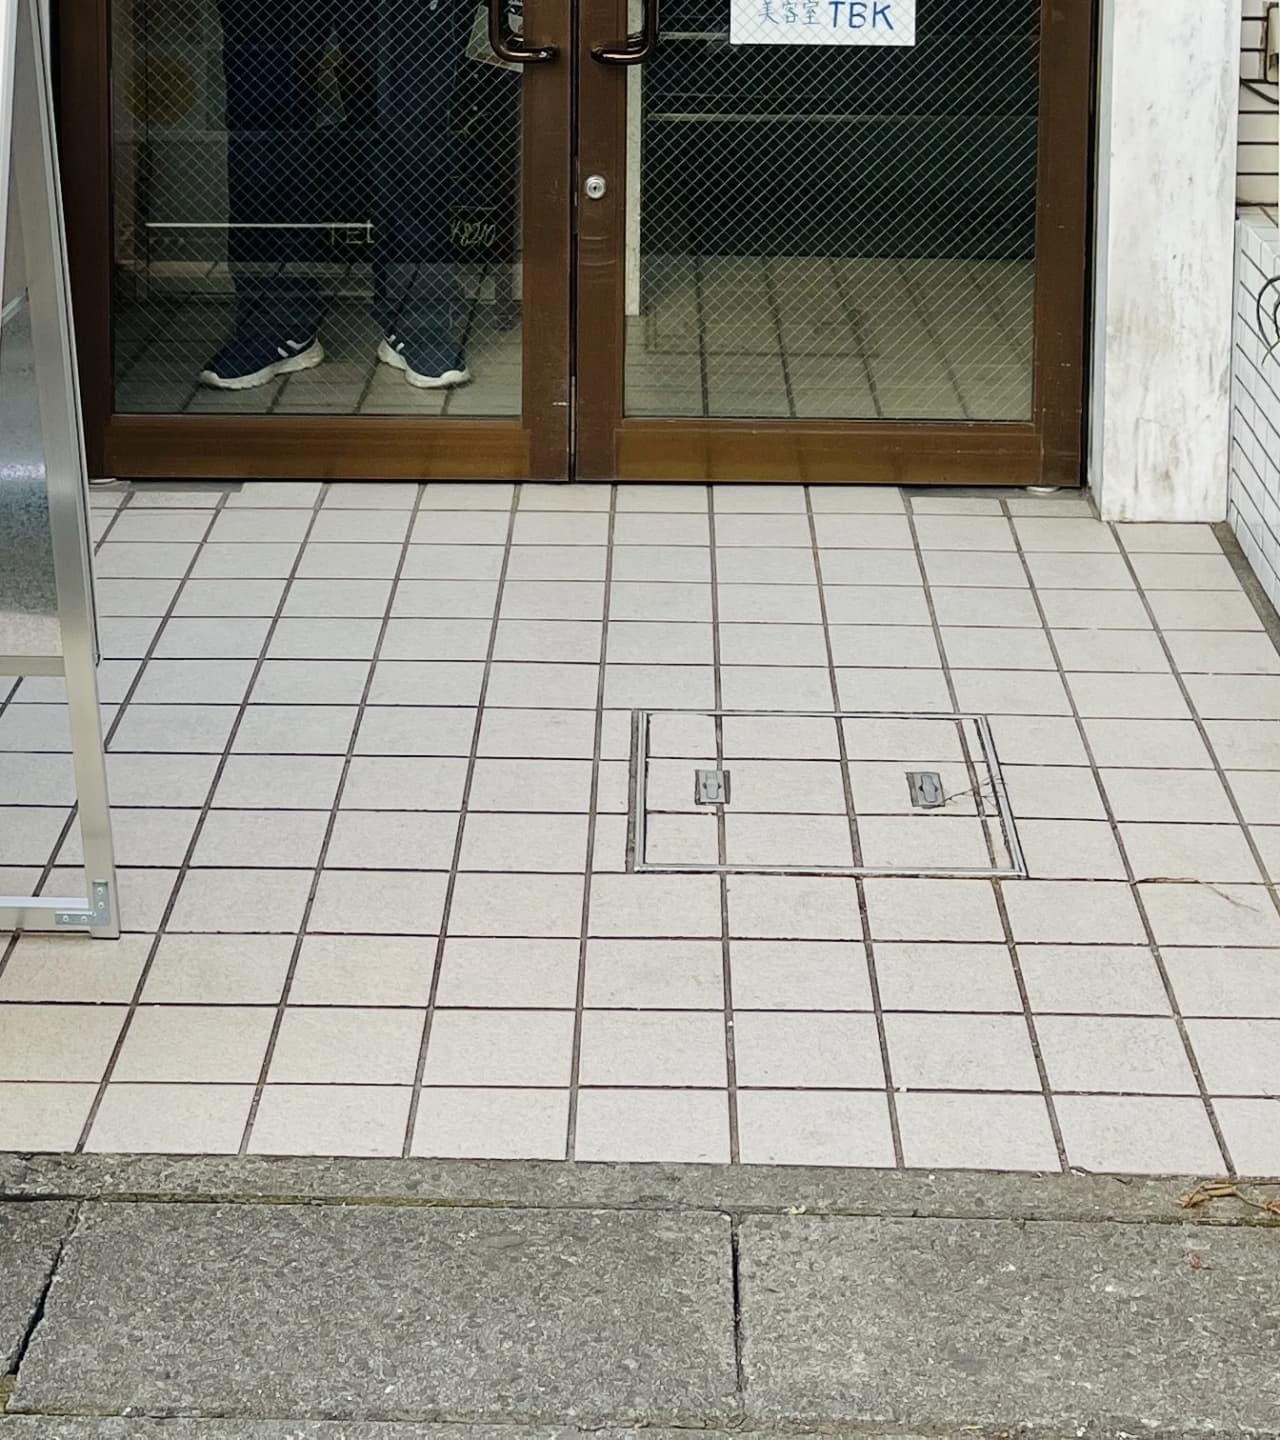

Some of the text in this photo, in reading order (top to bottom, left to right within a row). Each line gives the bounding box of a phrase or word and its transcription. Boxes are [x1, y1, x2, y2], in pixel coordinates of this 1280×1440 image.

[758, 0, 895, 31] 美容室 TBK
